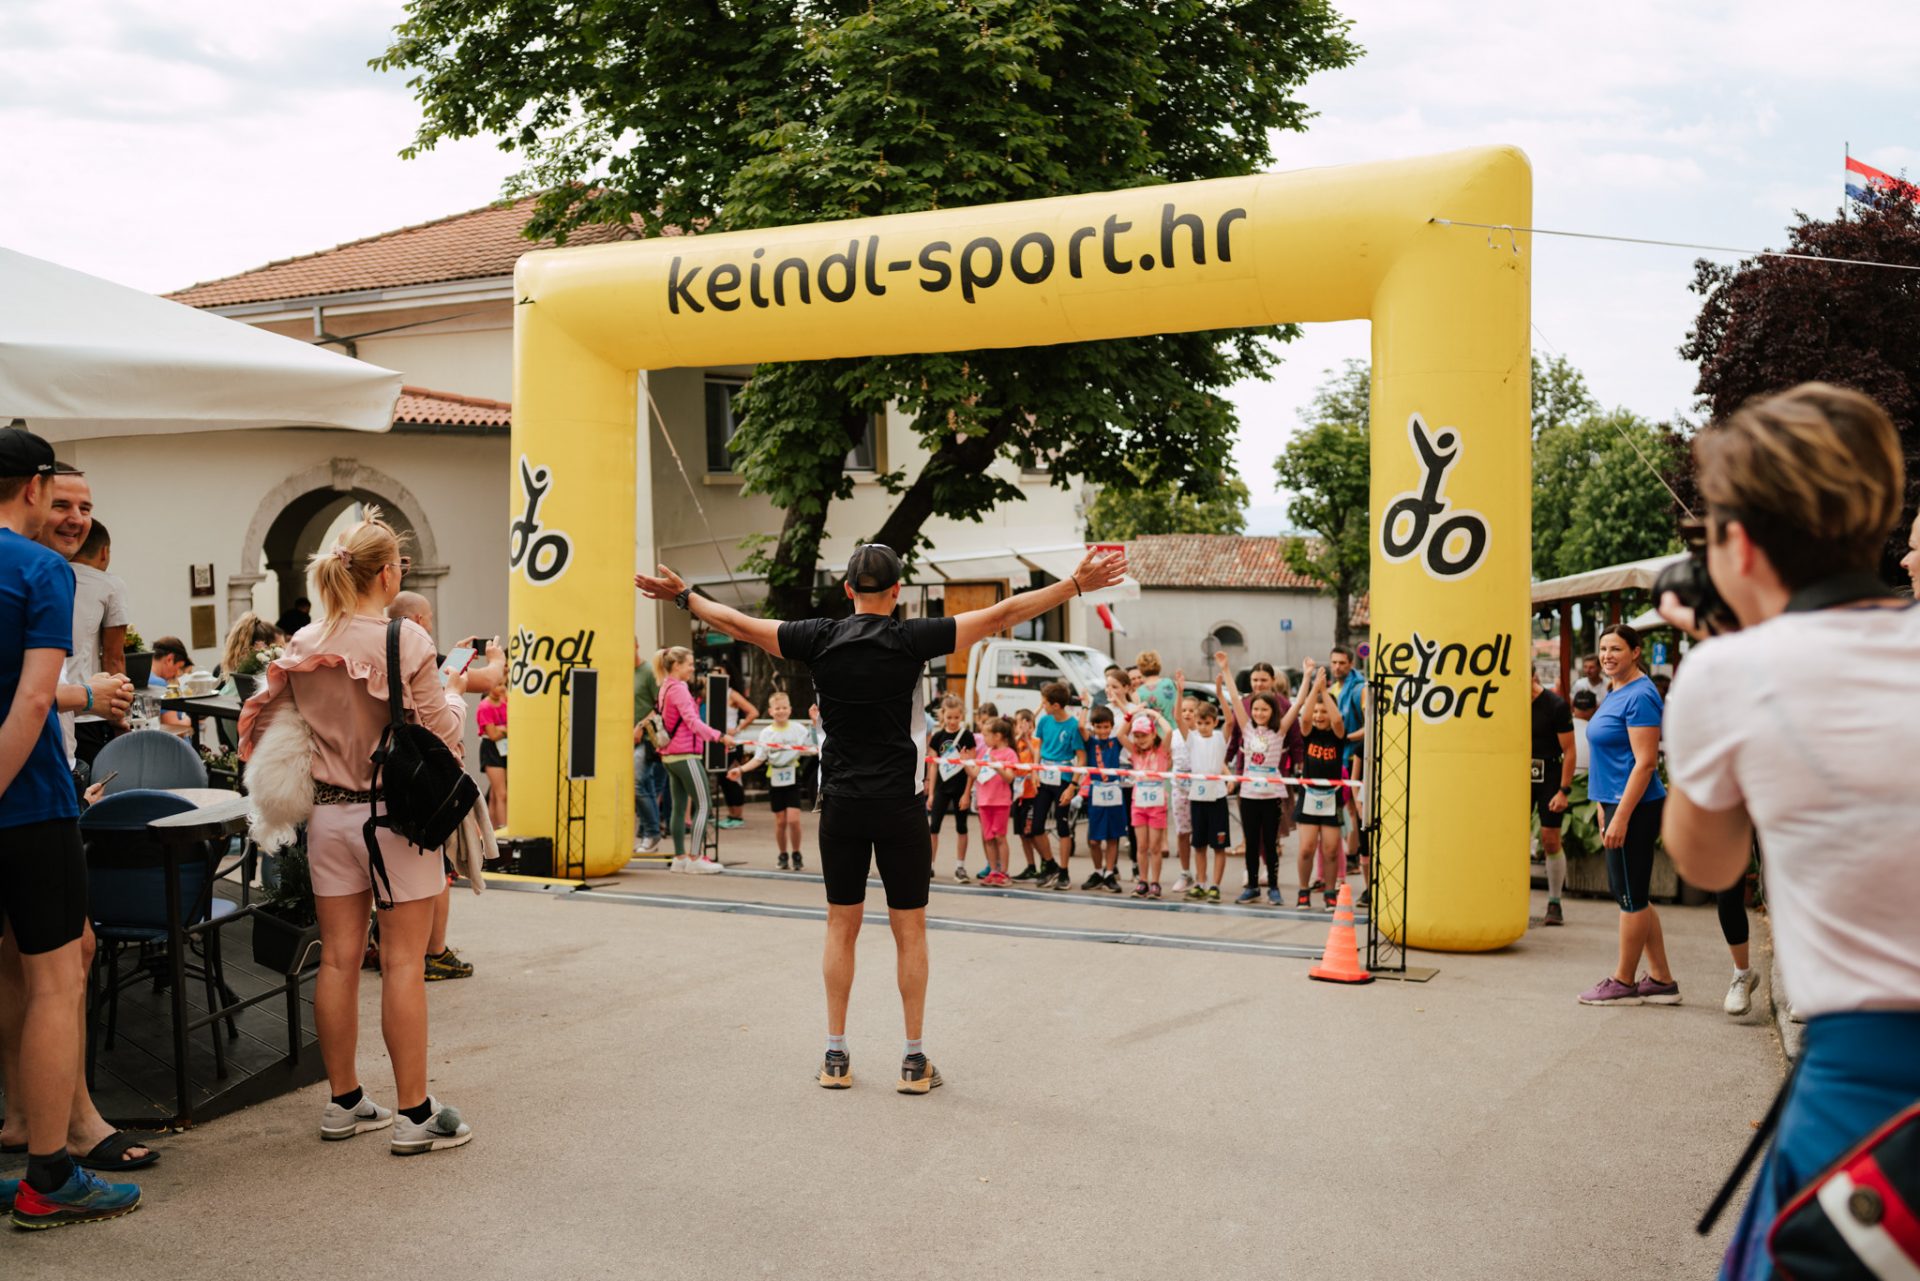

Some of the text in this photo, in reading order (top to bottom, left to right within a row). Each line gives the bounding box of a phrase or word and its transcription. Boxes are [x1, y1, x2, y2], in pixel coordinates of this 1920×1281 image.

[667, 202, 1247, 314] keindl-sport.hr
[1376, 678, 1499, 719] sport
[778, 771, 791, 781] 12
[1100, 790, 1115, 802] 15
[1141, 790, 1158, 802] 16
[1198, 784, 1207, 796] 9
[1315, 799, 1324, 811] 8
